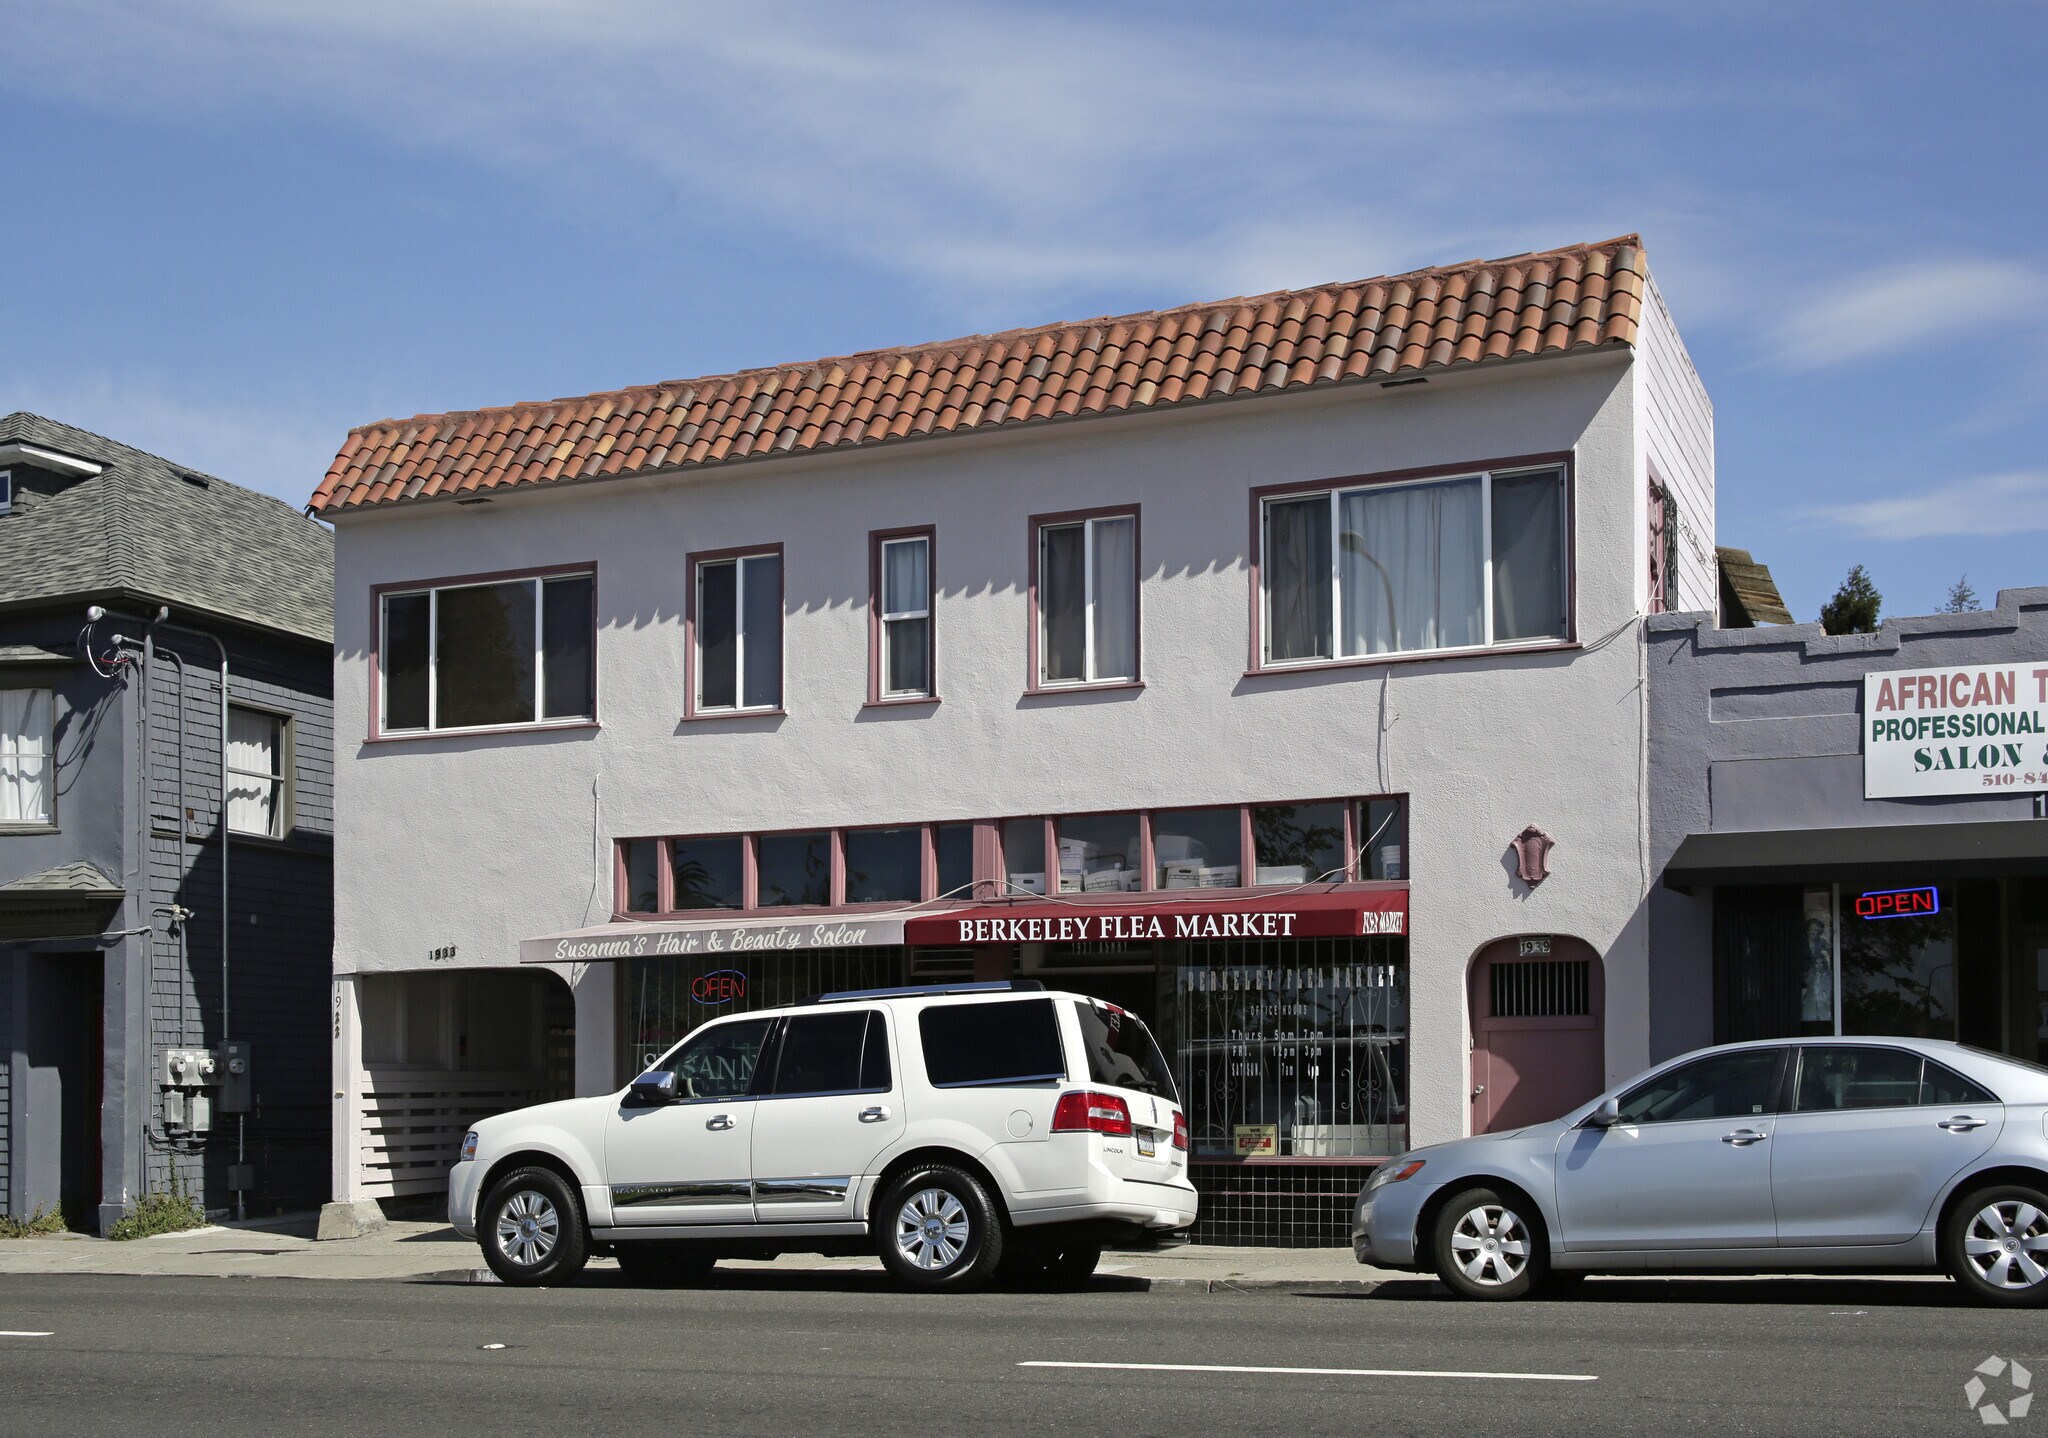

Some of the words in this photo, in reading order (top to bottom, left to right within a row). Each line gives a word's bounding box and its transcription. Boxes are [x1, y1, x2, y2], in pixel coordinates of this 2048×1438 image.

[1875, 670, 2015, 712] AFRICAN
[1872, 710, 2045, 742] PROFESSIONAL
[1914, 743, 2023, 773] SALON
[1855, 893, 1931, 915] OPEN
[555, 934, 648, 959] Susanna's
[656, 933, 699, 954] Hair
[707, 930, 724, 951] &
[729, 926, 801, 951] Beauty
[810, 923, 866, 946] Salon
[958, 917, 1091, 942] BERKELEY
[1099, 915, 1166, 939] FLEA
[1174, 913, 1297, 938] MARKET
[691, 977, 746, 999] OPEN
[1188, 969, 1273, 992] BERKELEY
[1287, 967, 1324, 990] FLEA
[1333, 965, 1395, 988] MARKET
[1250, 1004, 1278, 1016] OFFICE
[1282, 1004, 1307, 1015] HOURS
[1231, 1029, 1267, 1041] Thurs.
[1274, 1029, 1295, 1043] 5pm
[1303, 1028, 1324, 1042] 7pm
[1304, 1044, 1322, 1058] 3pm
